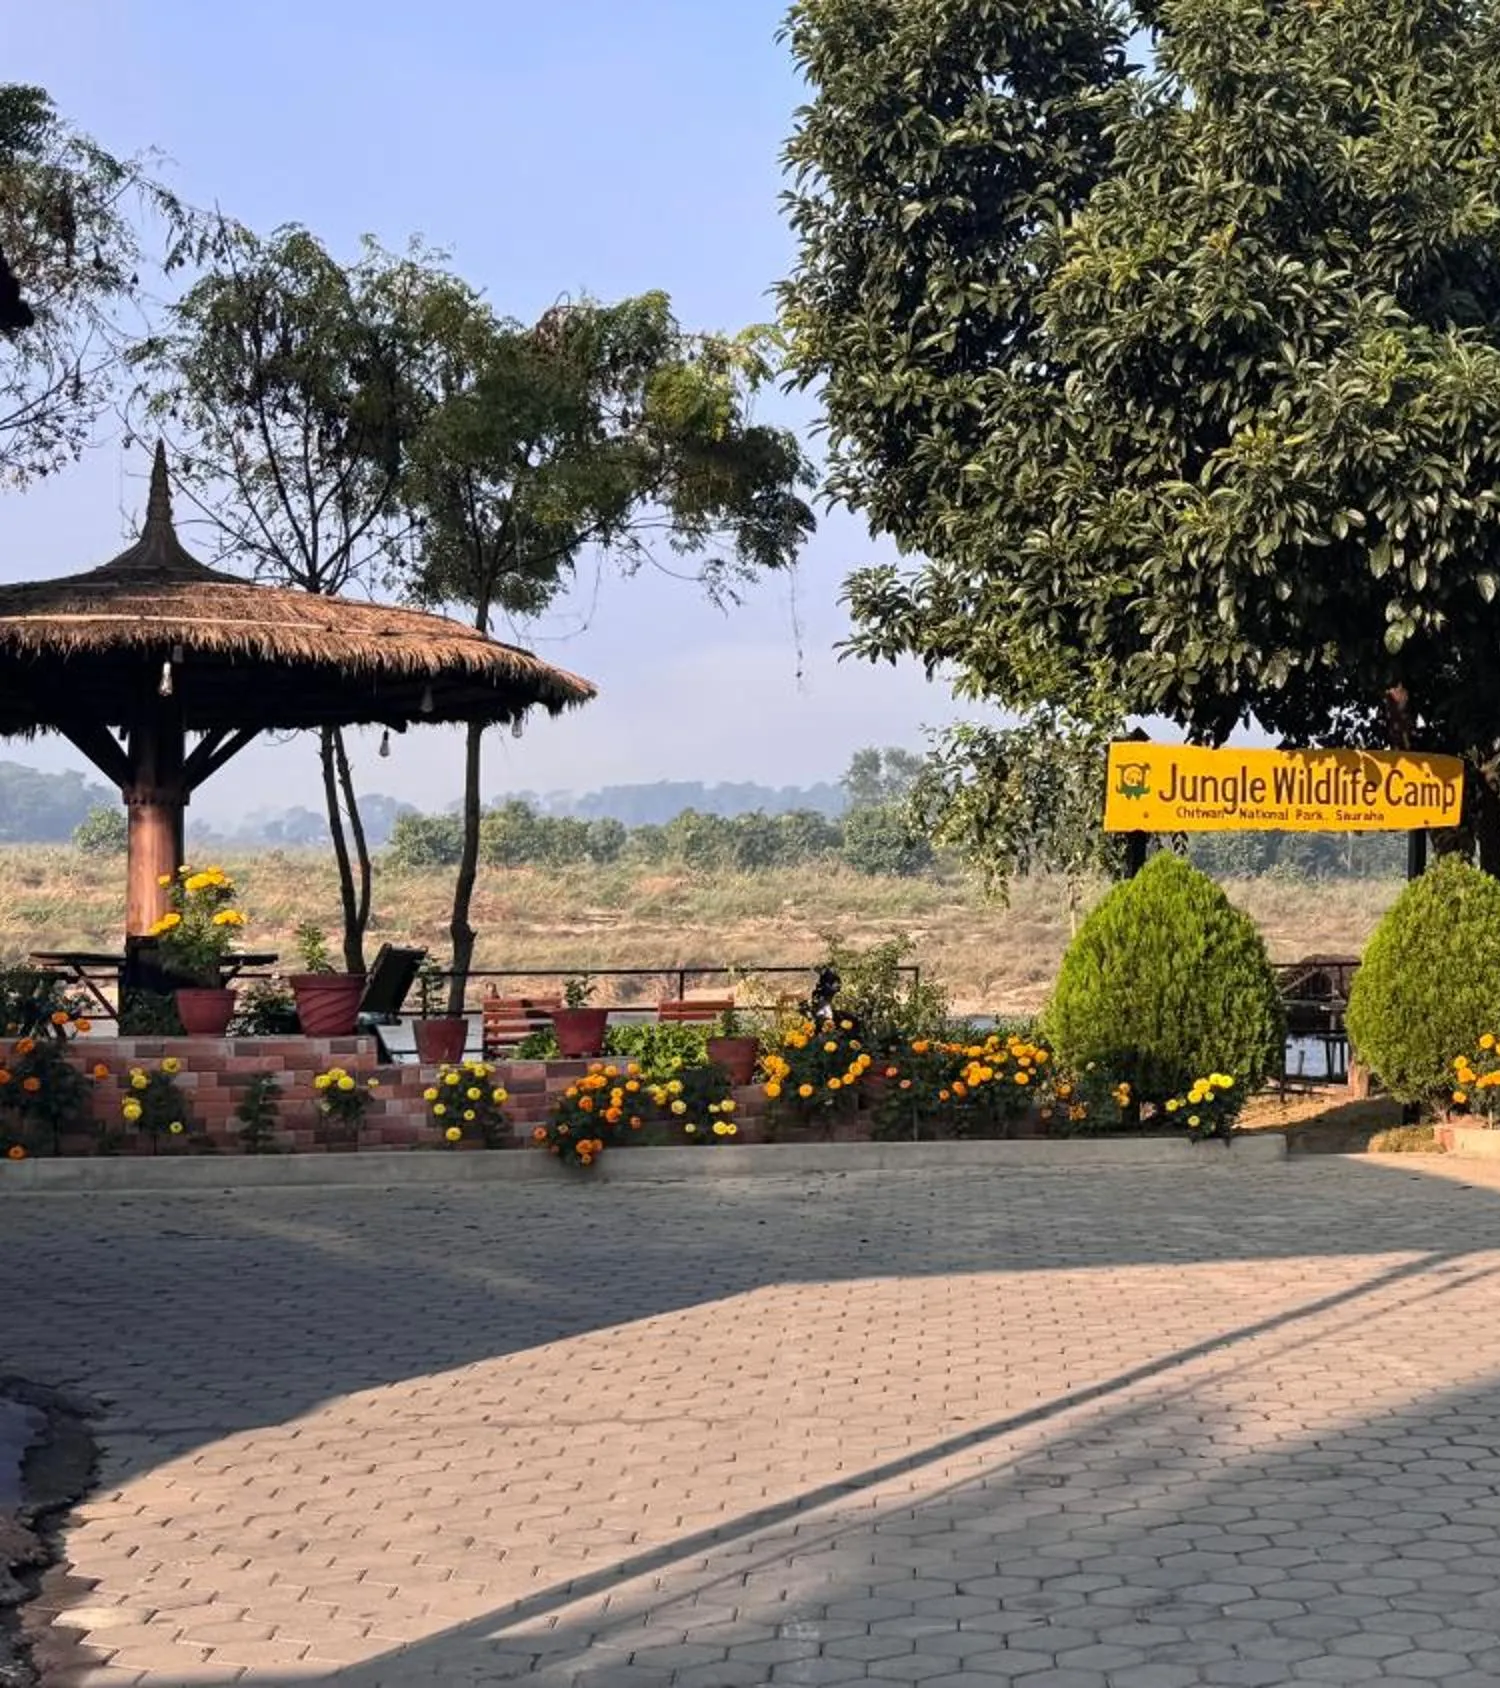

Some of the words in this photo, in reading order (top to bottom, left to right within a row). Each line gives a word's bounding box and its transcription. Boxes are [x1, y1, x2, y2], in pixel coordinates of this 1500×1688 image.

[1158, 763, 1266, 814] Jungle
[1273, 766, 1377, 806] Wildlife
[1385, 769, 1456, 814] Camp
[1240, 808, 1288, 821] National
[1336, 809, 1385, 821] Sauraha
